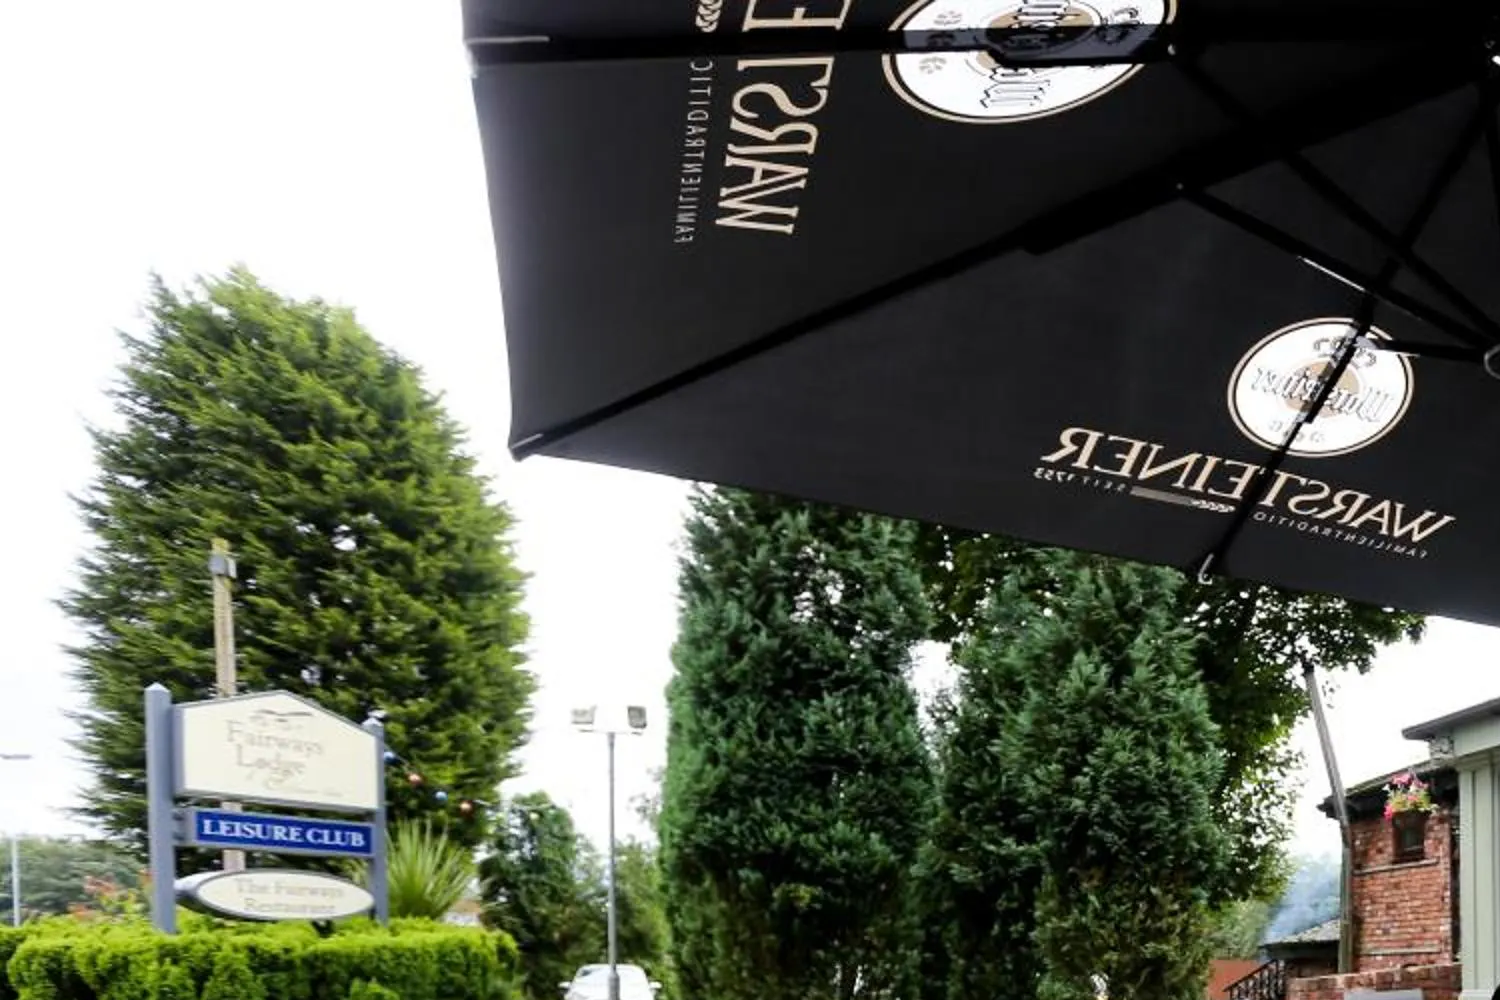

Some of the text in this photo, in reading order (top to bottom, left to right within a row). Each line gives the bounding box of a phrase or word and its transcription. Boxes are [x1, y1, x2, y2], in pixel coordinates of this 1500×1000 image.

[226, 719, 324, 757] Fairways
[235, 744, 306, 782] Lodge
[203, 819, 365, 847] LEISURE CLUB
